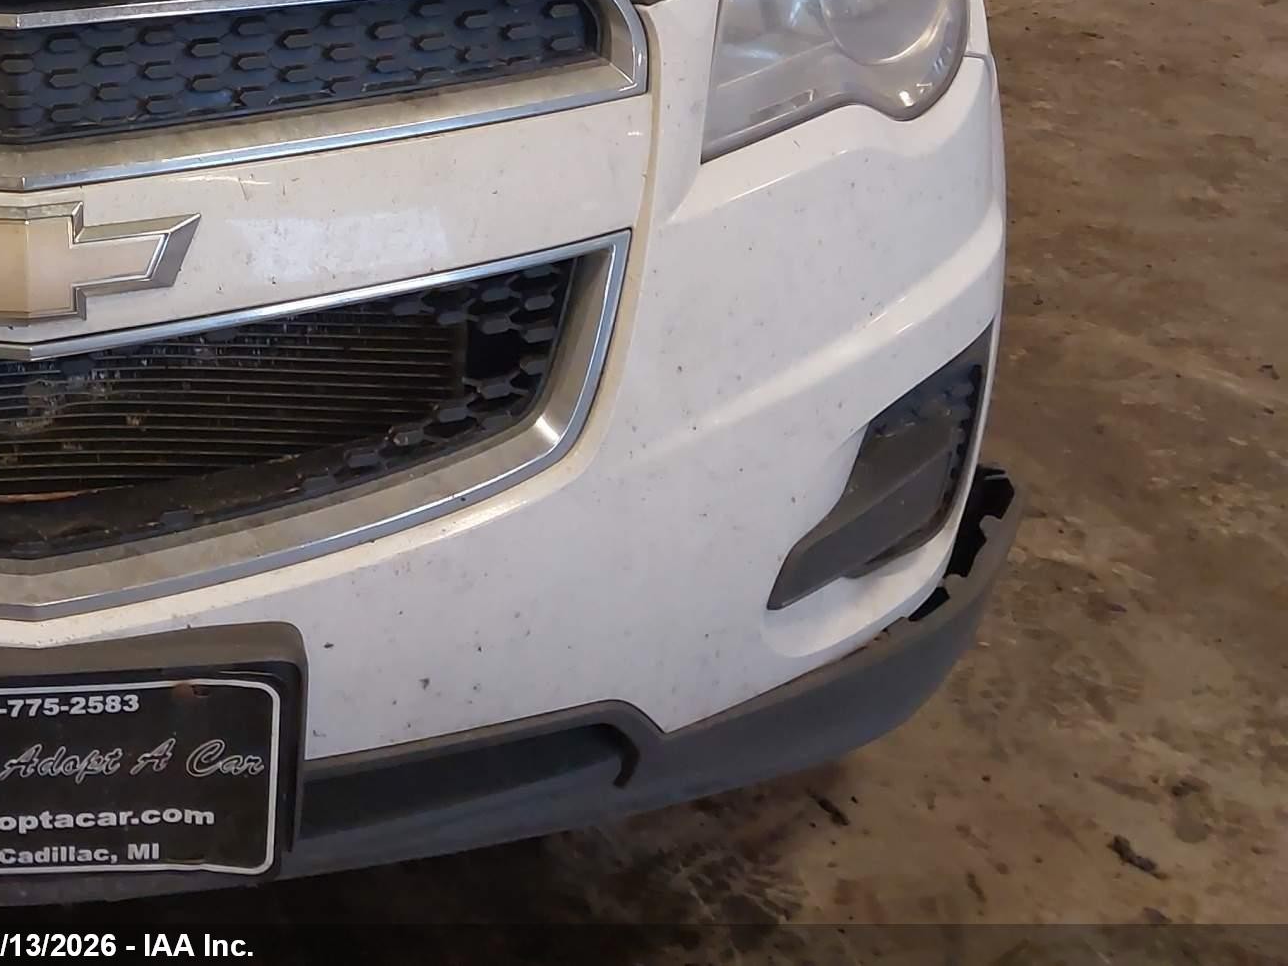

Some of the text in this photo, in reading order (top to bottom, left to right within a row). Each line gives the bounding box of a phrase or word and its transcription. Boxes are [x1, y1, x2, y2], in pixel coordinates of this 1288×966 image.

[129, 737, 177, 776] A
[185, 738, 265, 778] Car
[127, 842, 160, 861] MI
